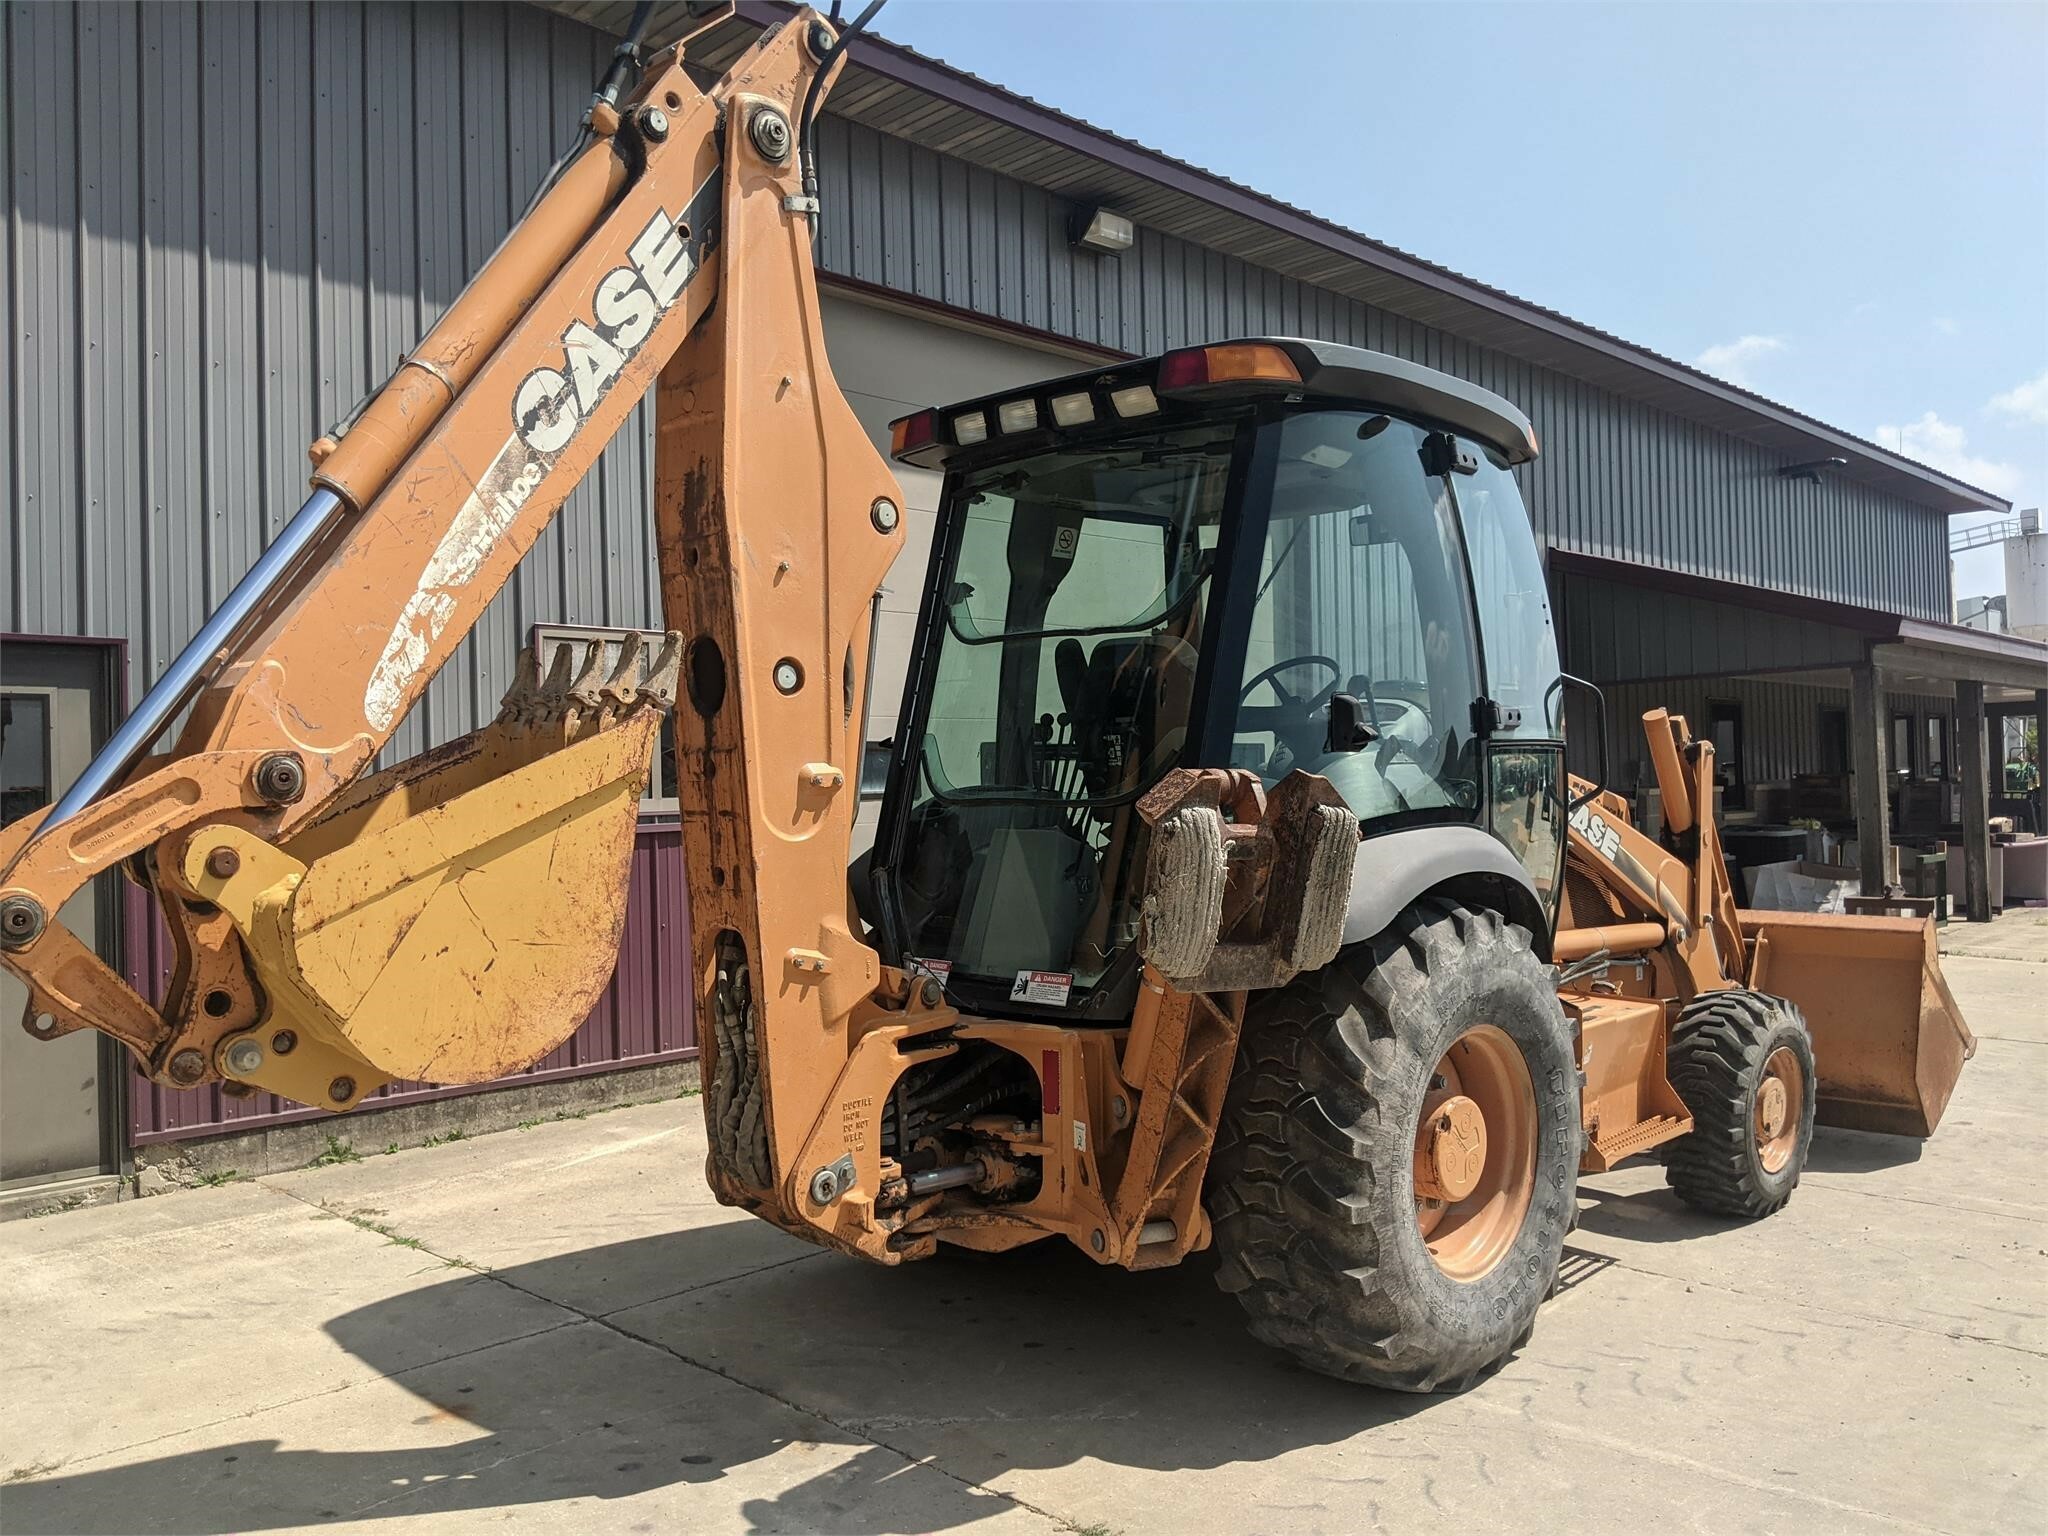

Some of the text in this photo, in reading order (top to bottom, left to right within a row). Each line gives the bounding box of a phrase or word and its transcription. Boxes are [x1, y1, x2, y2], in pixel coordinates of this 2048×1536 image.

[512, 206, 695, 453] CASE
[1567, 788, 1621, 863] ASE
[1043, 975, 1067, 983] DANGER
[842, 1097, 873, 1111] DUCTILE
[843, 1111, 860, 1122] IRON
[855, 1119, 870, 1130] NOT
[843, 1132, 863, 1143] WELD
